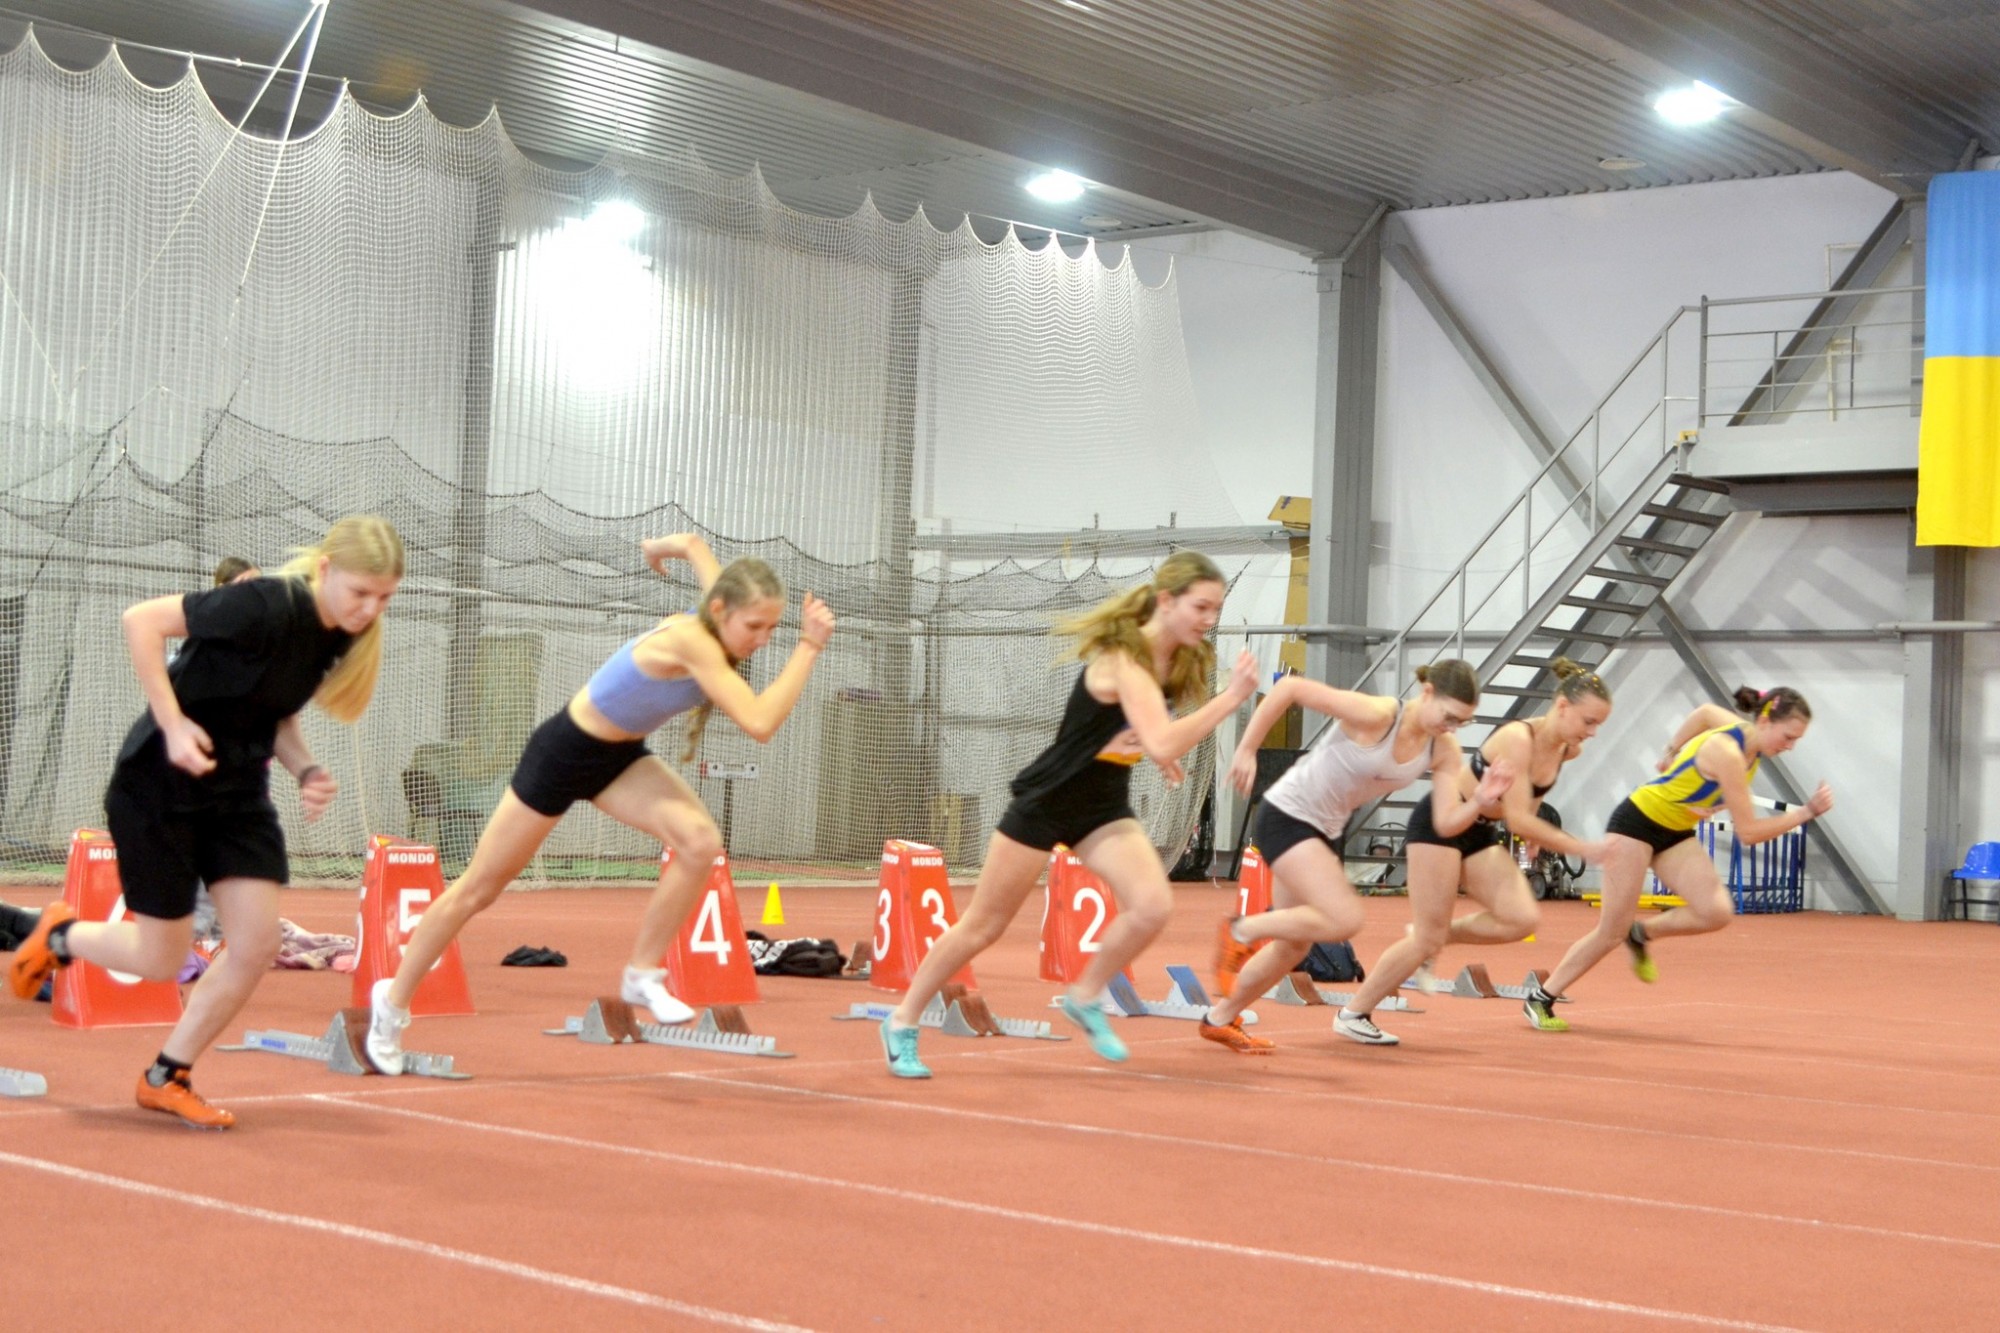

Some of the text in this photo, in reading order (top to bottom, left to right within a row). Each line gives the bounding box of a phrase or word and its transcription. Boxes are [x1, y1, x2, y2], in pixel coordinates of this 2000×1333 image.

[388, 852, 435, 864] MONDO
[911, 857, 943, 866] MONDO
[690, 889, 732, 965] 4
[874, 888, 892, 961] 3
[921, 888, 951, 950] 3
[1073, 887, 1105, 952] 2
[1240, 888, 1249, 916] 1
